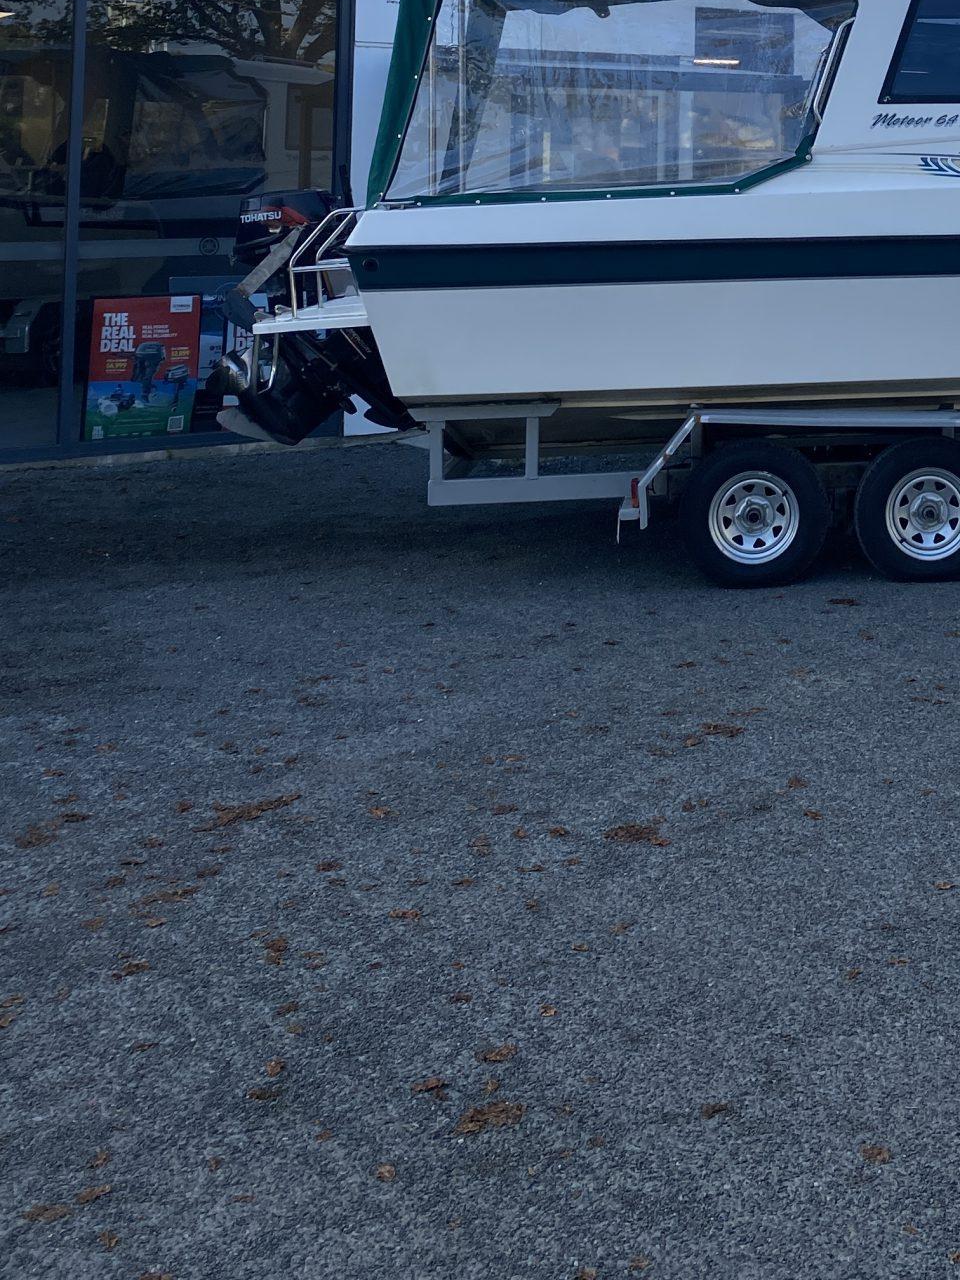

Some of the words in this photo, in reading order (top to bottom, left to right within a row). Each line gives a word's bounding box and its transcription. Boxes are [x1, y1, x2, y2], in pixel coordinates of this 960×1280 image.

[239, 210, 282, 224] TOHATSU
[103, 312, 129, 326] THE
[101, 325, 137, 339] REAL
[100, 339, 137, 352] DEAL
